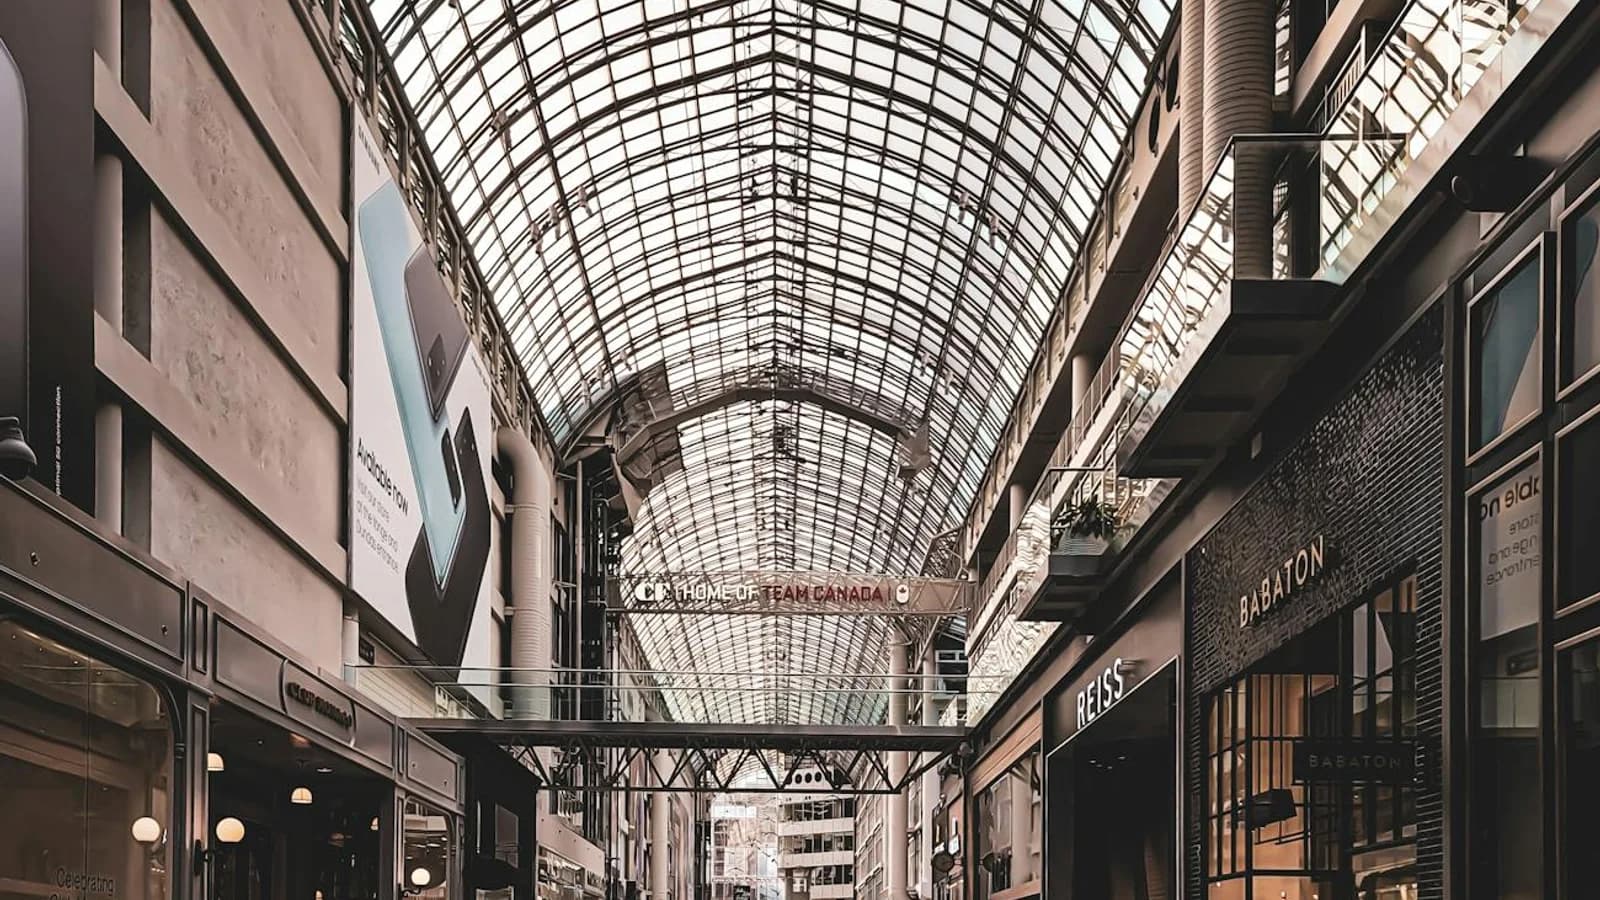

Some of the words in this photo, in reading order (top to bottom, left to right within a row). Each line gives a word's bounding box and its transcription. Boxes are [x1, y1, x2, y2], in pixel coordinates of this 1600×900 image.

[357, 436, 391, 497] Available
[393, 485, 409, 517] now
[683, 583, 731, 602] HOME
[735, 583, 758, 601] OF
[762, 585, 808, 601] TEAM
[814, 585, 884, 602] CANADA
[1240, 534, 1323, 629] BABATON
[1077, 658, 1123, 730] REISS
[1309, 753, 1401, 769] BABATON
[56, 867, 114, 897] Celebrating
